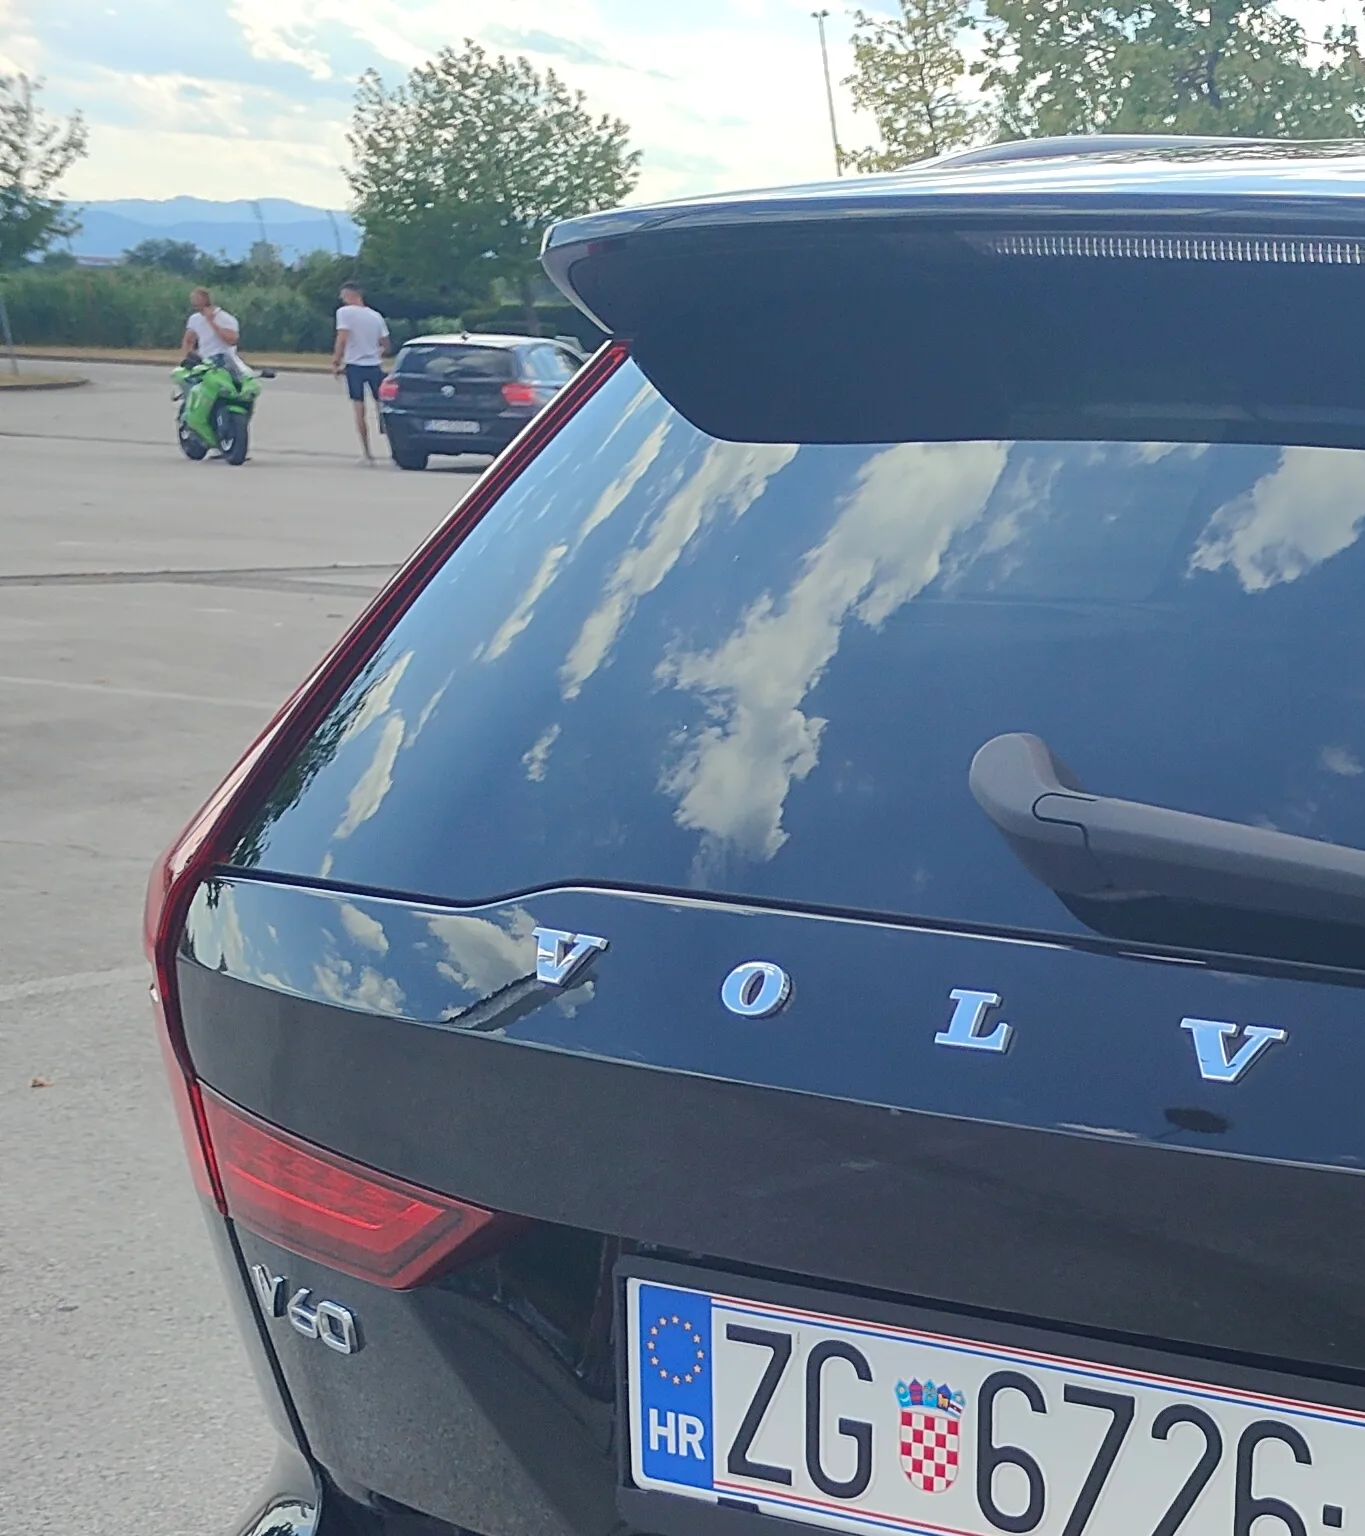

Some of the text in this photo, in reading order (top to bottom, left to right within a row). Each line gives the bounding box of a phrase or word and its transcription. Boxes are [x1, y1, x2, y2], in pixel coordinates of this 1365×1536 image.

[252, 1264, 358, 1354] V60
[649, 1408, 705, 1460] HR
[725, 1323, 875, 1499] ZG
